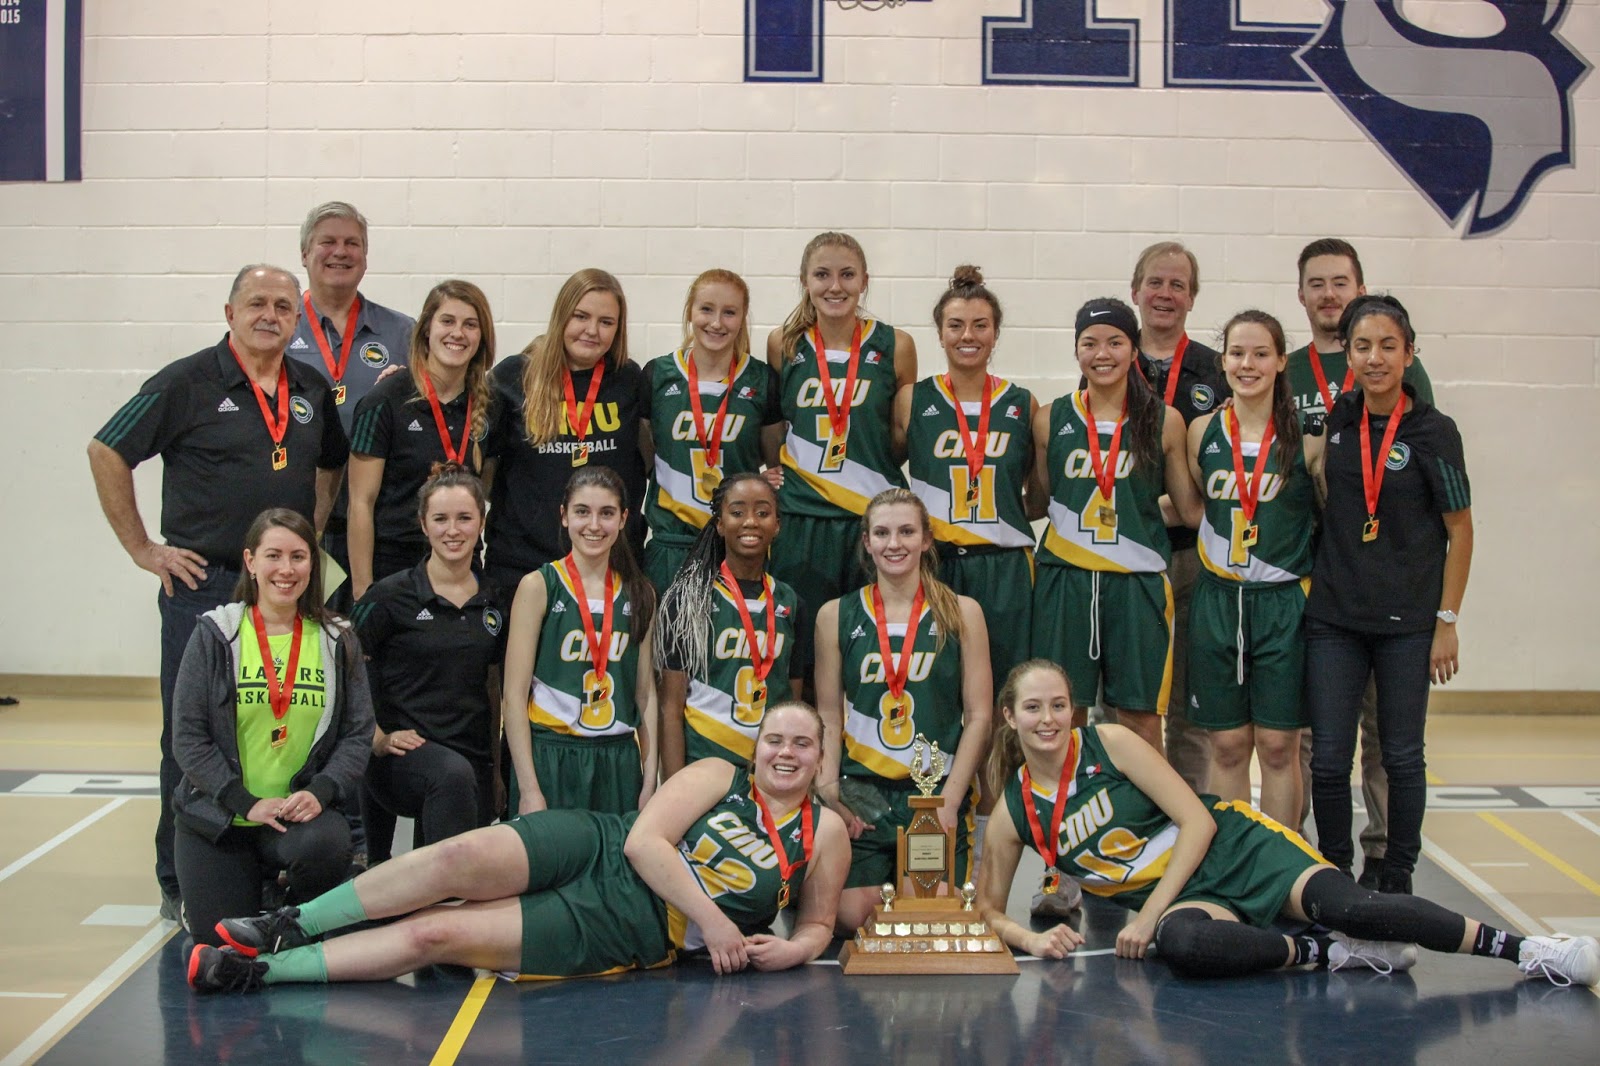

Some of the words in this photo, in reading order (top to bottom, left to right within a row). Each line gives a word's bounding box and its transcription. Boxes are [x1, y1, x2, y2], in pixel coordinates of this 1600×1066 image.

[0, 9, 21, 24] 015
[529, 401, 621, 436] MU
[796, 377, 871, 408] CMU
[1293, 390, 1344, 409] BLAZ
[671, 410, 746, 442] CMU
[816, 414, 850, 473] 7
[949, 465, 999, 524] 11
[1206, 469, 1283, 503] CMU
[1078, 486, 1118, 545] 4
[1227, 507, 1251, 568] 1
[236, 690, 326, 708] ASKBALL
[242, 665, 324, 684] LAZRS
[579, 669, 615, 730] 3
[732, 666, 767, 727] 9
[877, 689, 915, 751] 8
[707, 812, 779, 870] CMU
[1057, 787, 1114, 857] CMU
